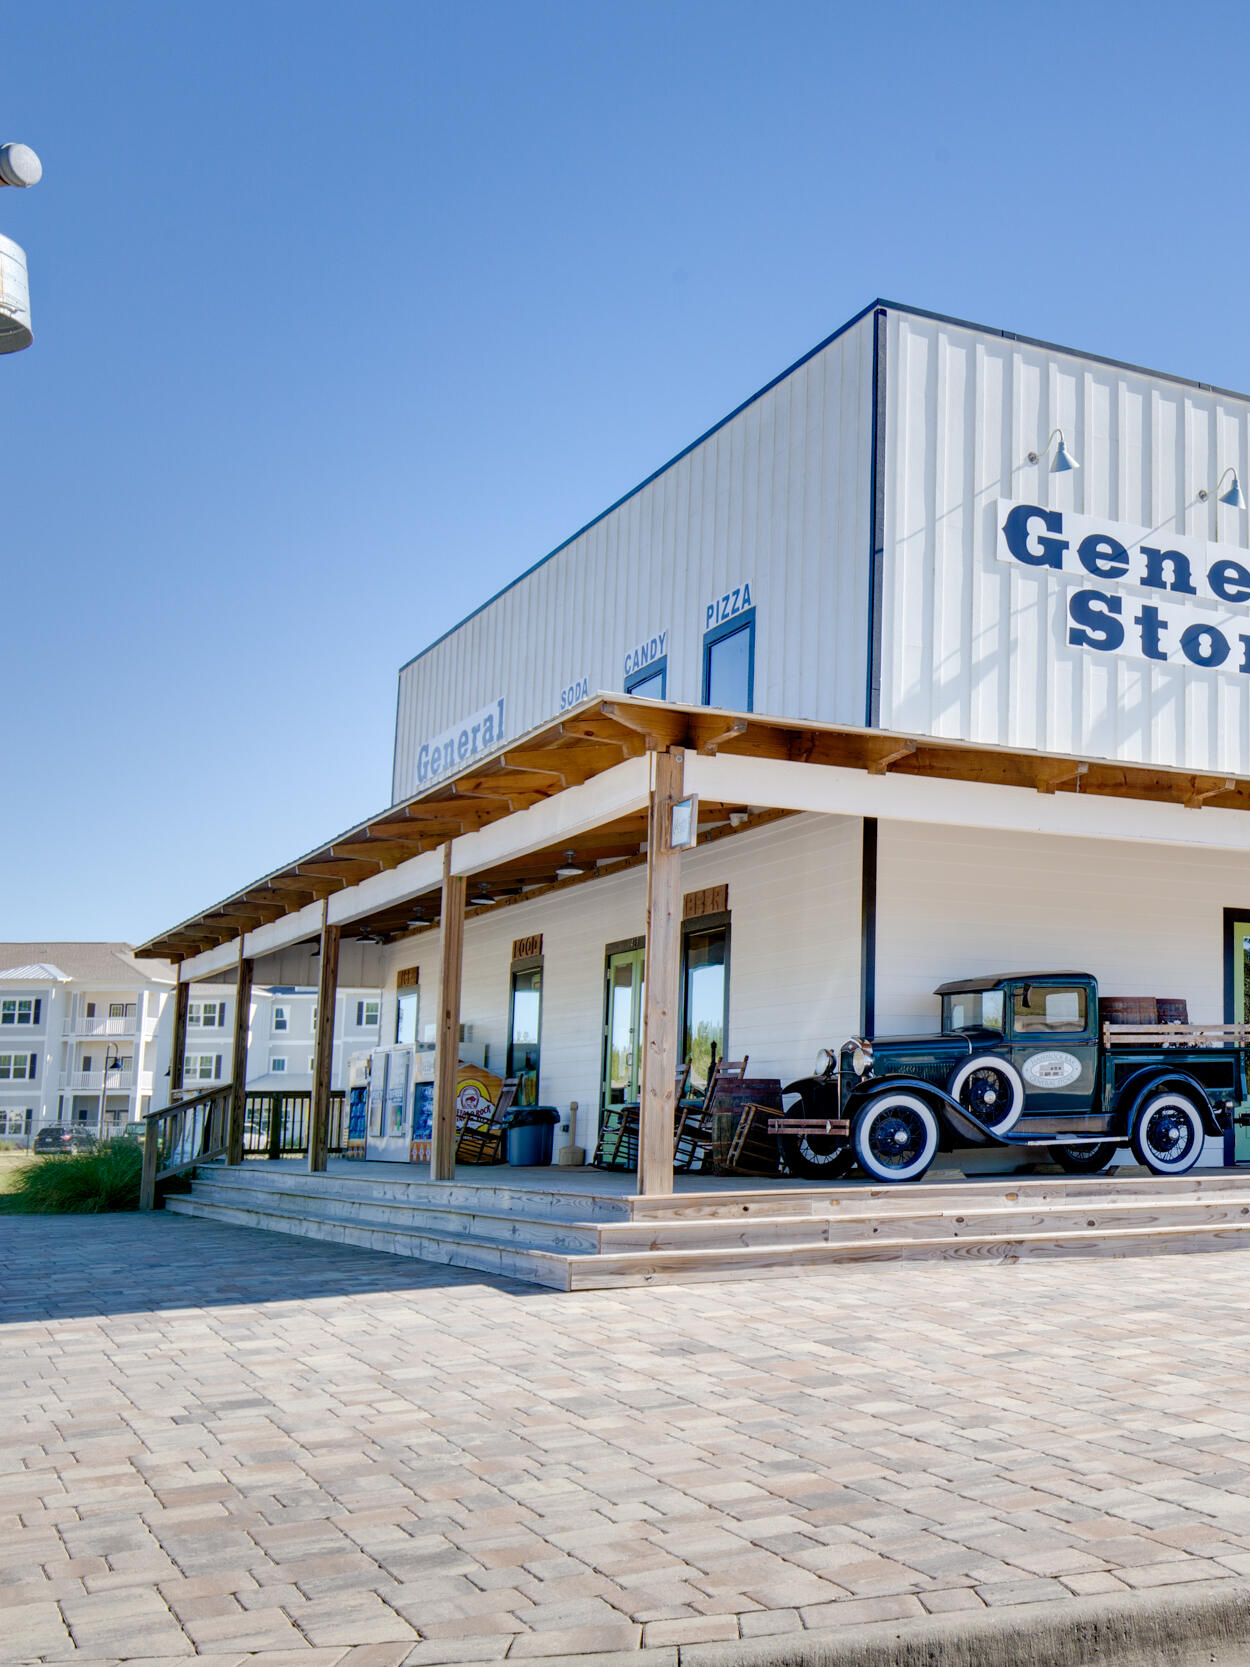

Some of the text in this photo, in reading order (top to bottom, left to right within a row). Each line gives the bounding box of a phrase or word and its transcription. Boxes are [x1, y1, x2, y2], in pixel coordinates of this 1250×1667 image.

[706, 583, 752, 630] PIZZA
[624, 631, 666, 676] CANDY
[560, 677, 589, 711] SODA
[416, 697, 505, 784] General
